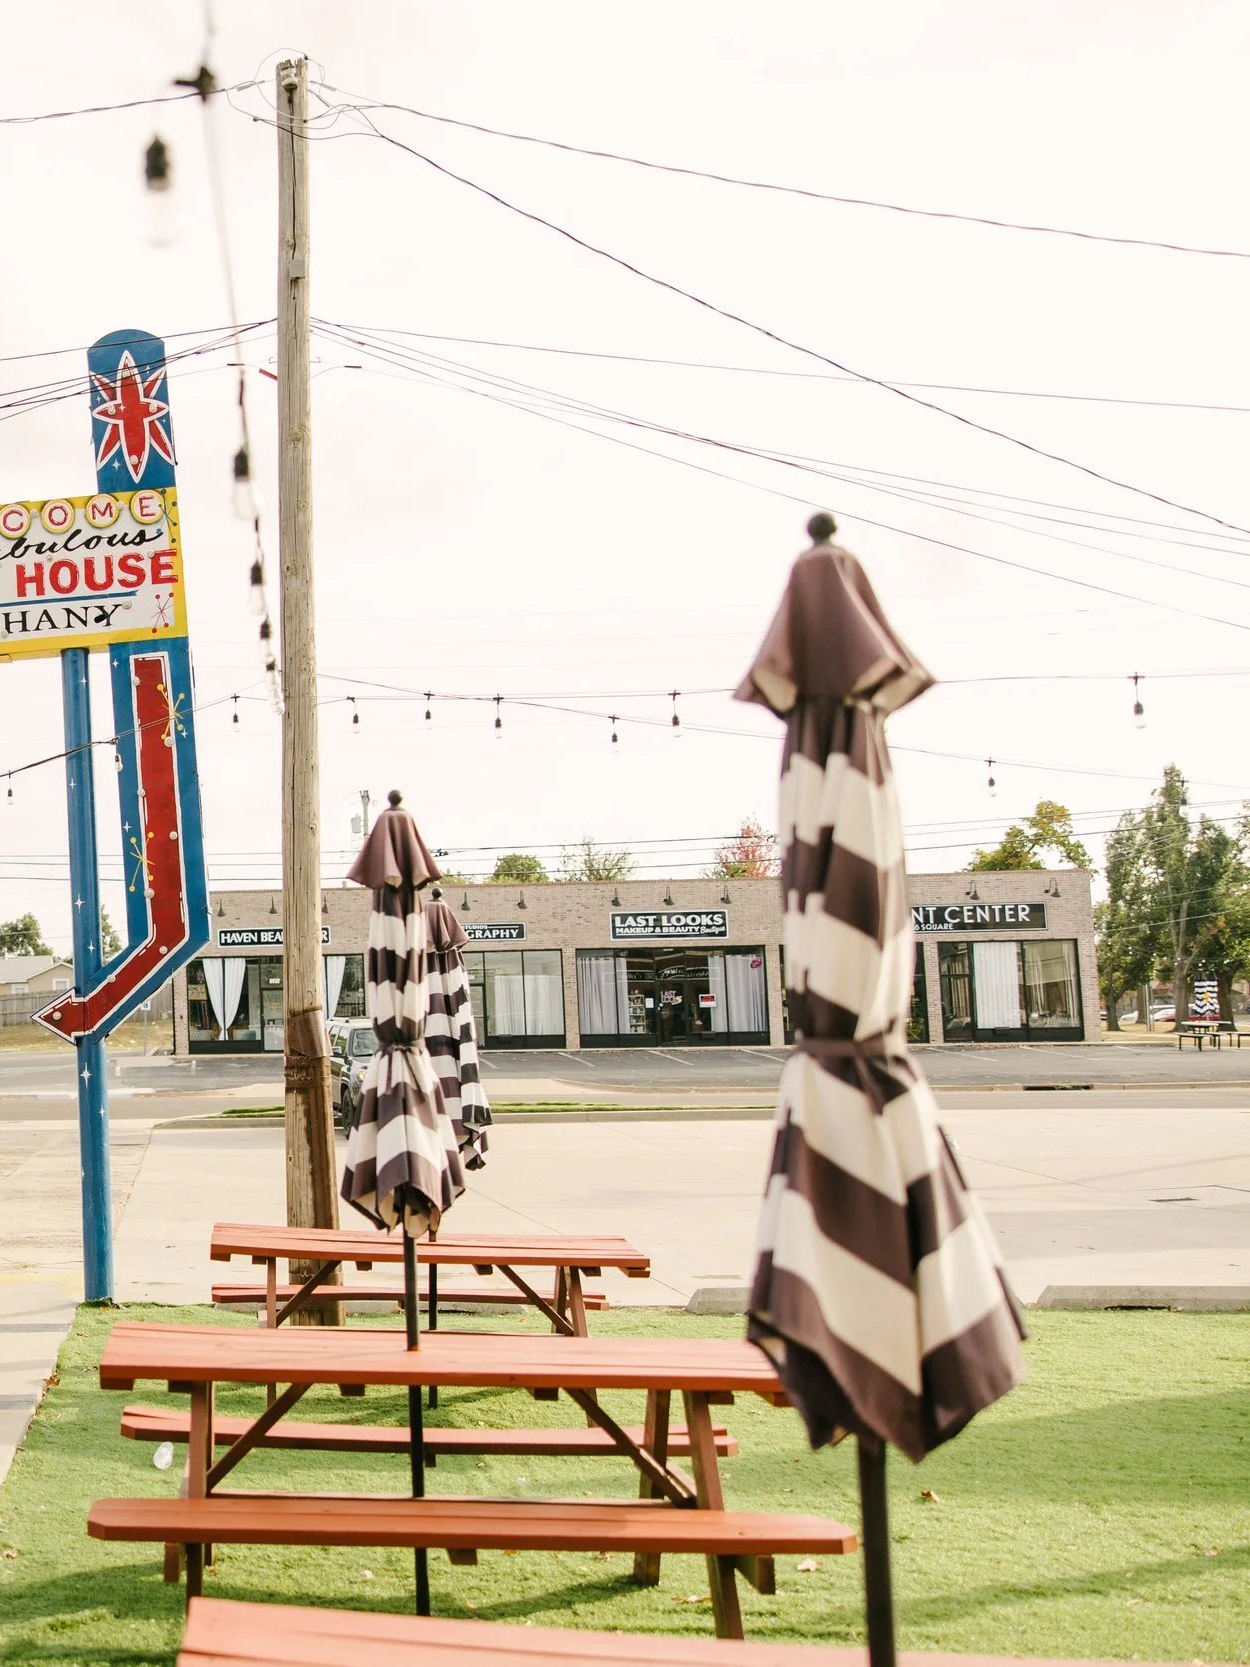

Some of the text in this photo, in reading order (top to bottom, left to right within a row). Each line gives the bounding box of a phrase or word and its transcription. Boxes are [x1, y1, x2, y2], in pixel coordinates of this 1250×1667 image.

[16, 549, 178, 598] HOUSE
[944, 904, 1030, 923] CENTER
[614, 914, 723, 927] LAST LOOKS
[220, 932, 259, 944] HAVEN
[466, 929, 519, 939] GRAPHY
